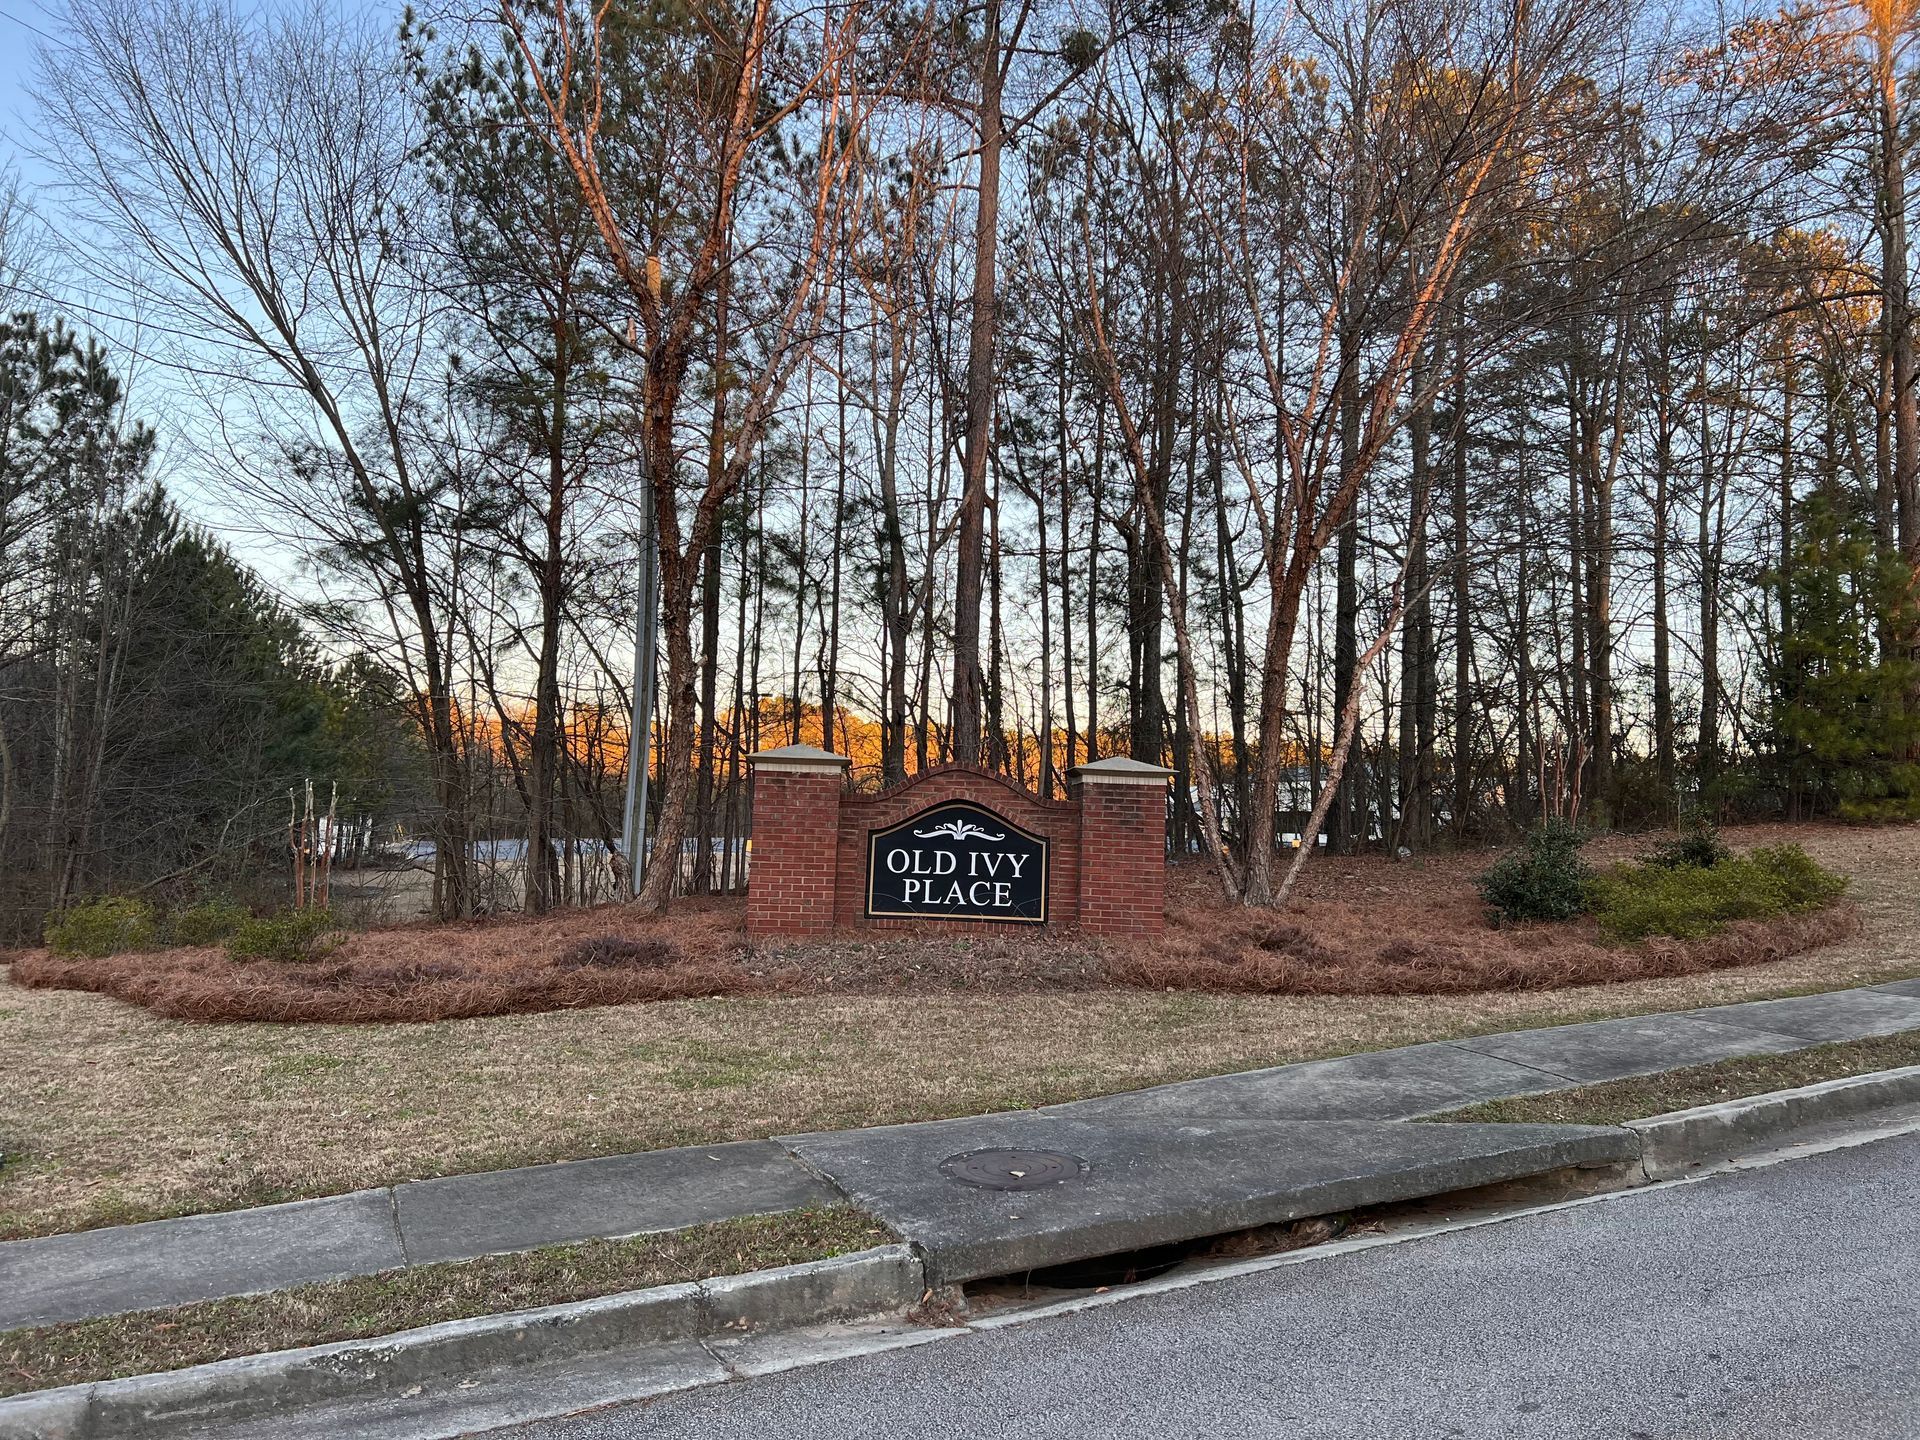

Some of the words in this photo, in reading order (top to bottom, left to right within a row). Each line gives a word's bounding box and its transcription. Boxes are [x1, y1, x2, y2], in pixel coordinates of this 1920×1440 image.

[886, 848, 957, 875] OLD
[967, 851, 1030, 878] IVY
[901, 878, 1013, 907] PLACE
